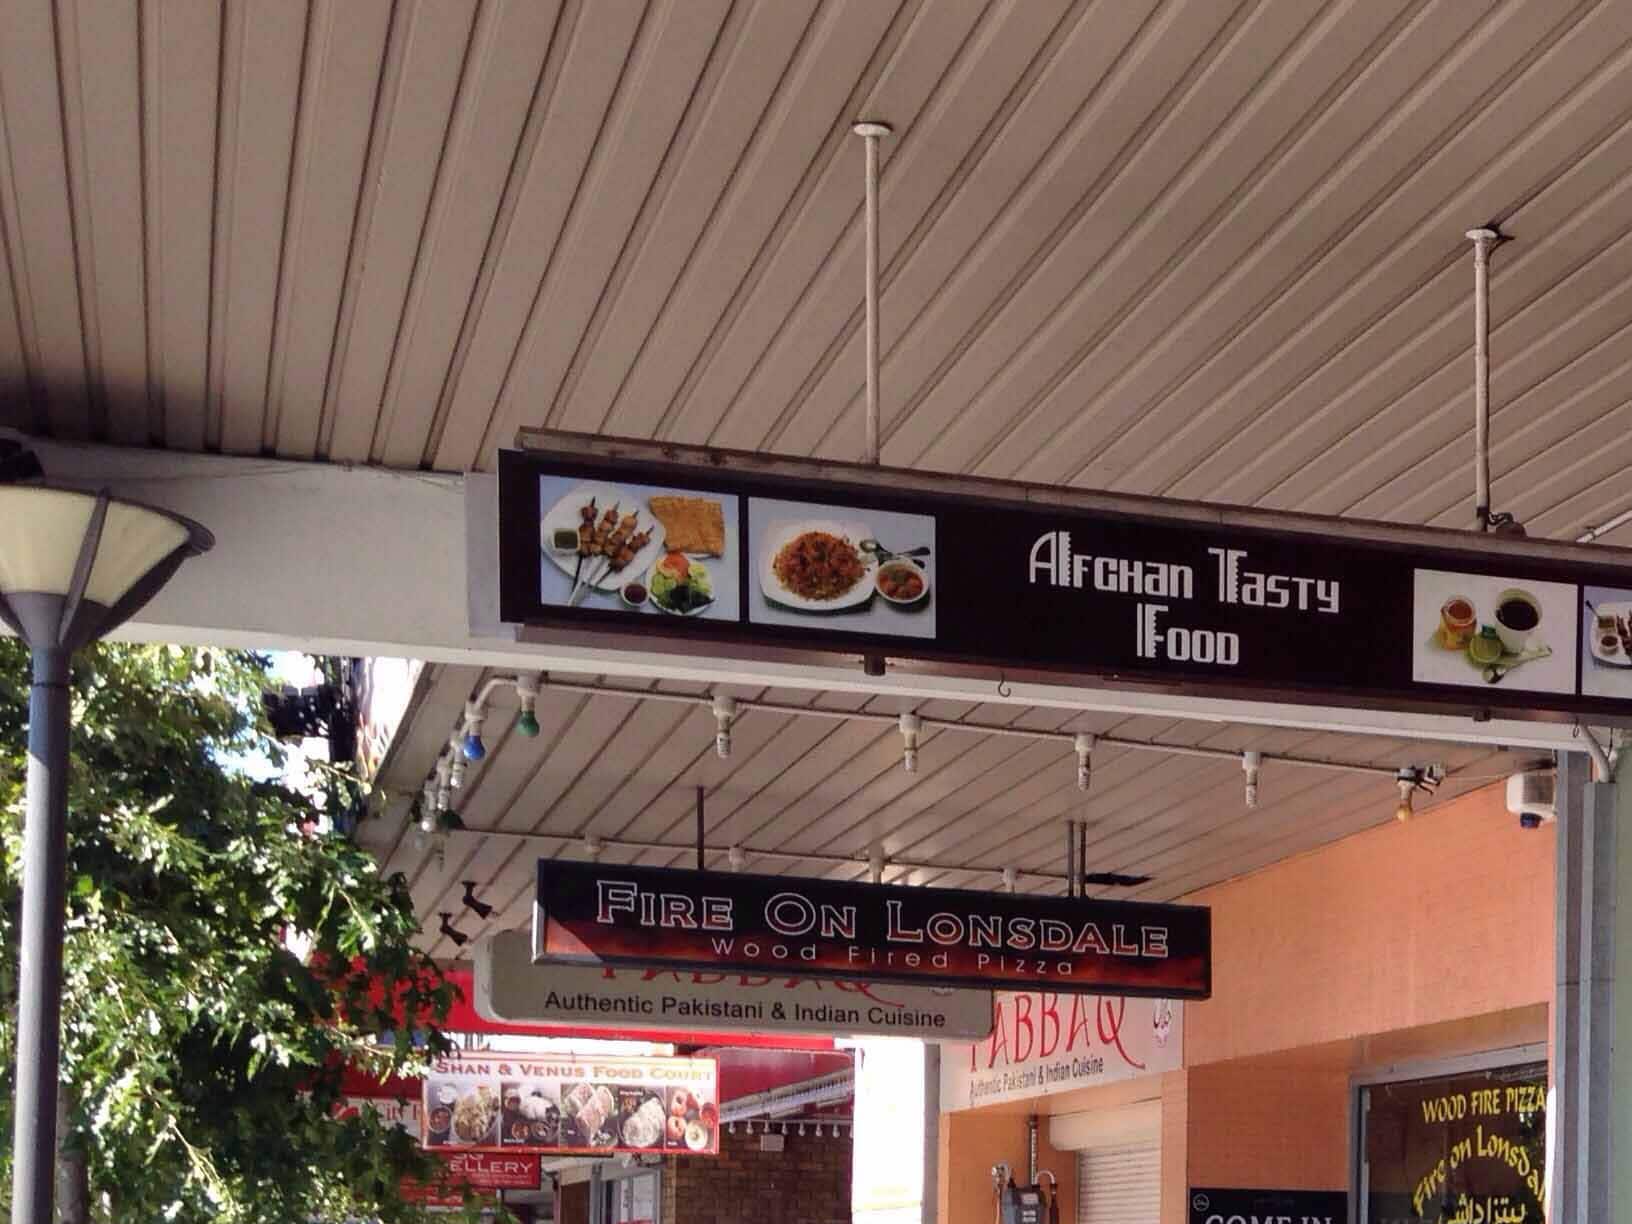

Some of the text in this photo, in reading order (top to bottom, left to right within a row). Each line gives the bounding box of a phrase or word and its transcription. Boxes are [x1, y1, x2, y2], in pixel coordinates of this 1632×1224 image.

[596, 880, 1169, 958] FIRE ON LONSDALE
[711, 937, 1073, 976] Wood Fired Pizza
[545, 990, 946, 1028] Authentic Pakistani & Indian Cuisine
[971, 992, 1146, 1071] ABBAQ
[498, 1064, 513, 1075] &
[520, 1063, 587, 1078] VENUS
[593, 1065, 644, 1080] FOOD
[1046, 1061, 1070, 1083] Indian
[1072, 1055, 1104, 1078] Cuisine
[1422, 1086, 1546, 1123] WOOD FIRE PIZZA
[1413, 1125, 1547, 1217] Fire on Lonsdal
